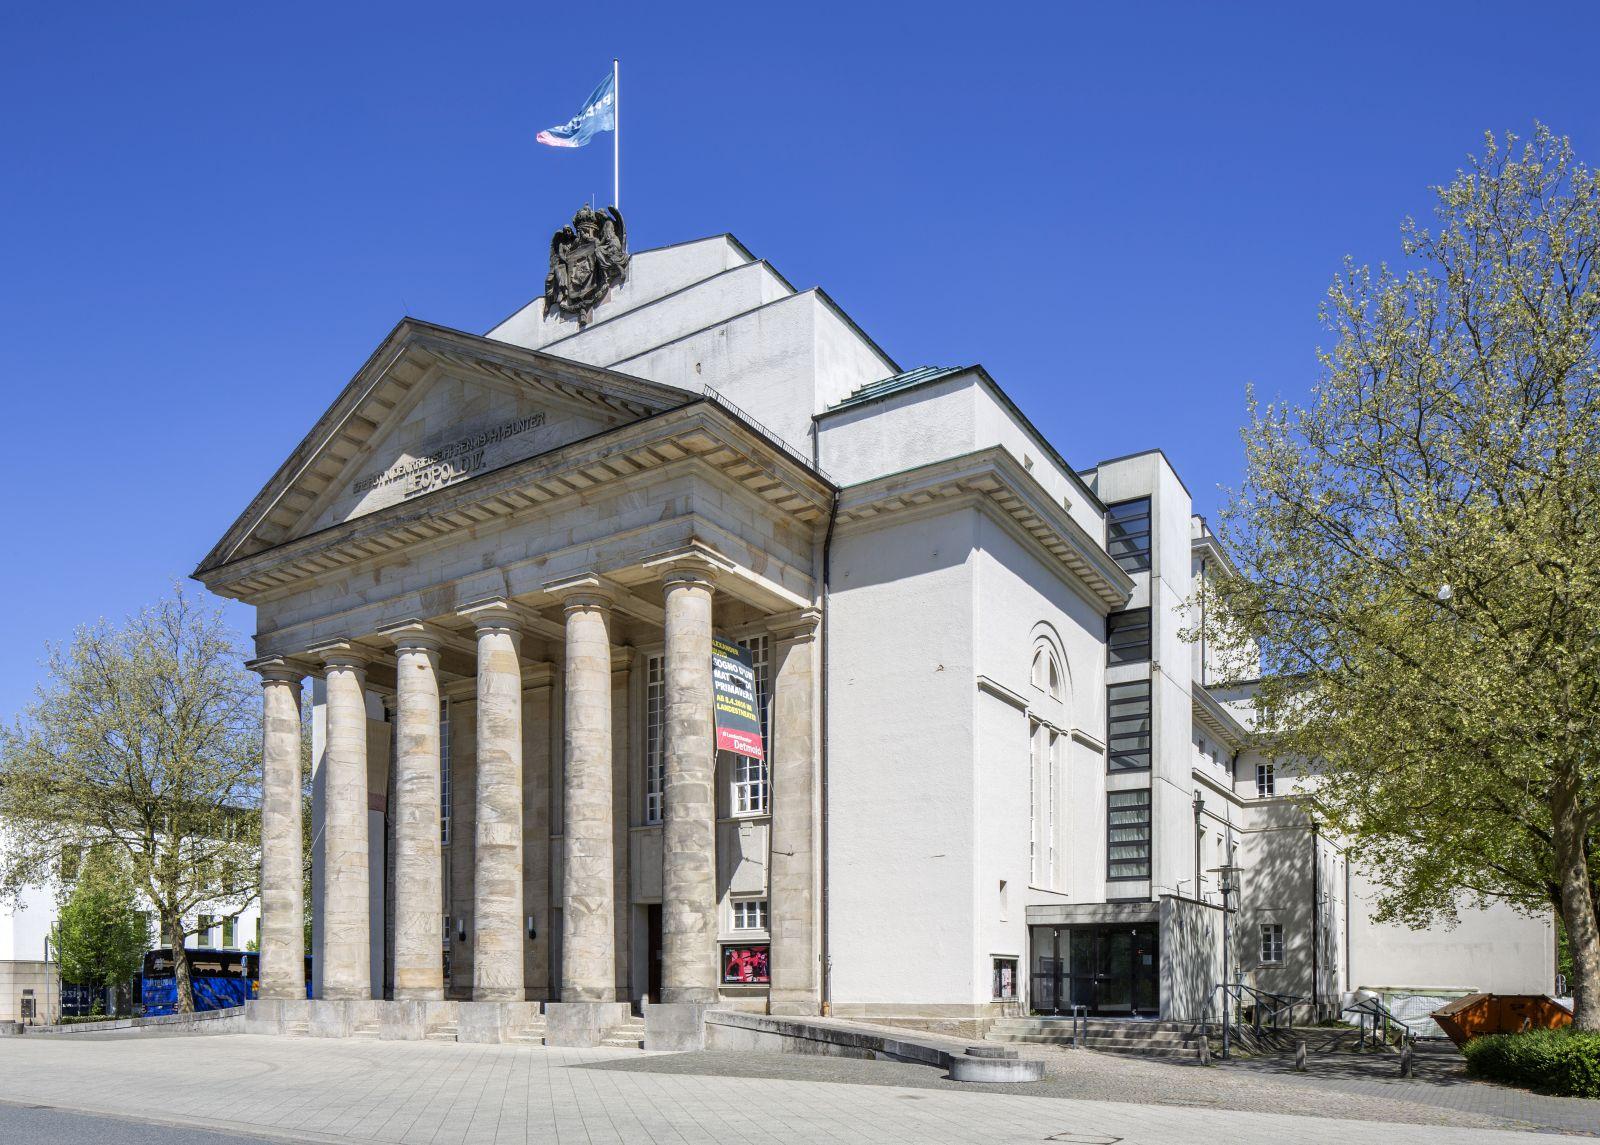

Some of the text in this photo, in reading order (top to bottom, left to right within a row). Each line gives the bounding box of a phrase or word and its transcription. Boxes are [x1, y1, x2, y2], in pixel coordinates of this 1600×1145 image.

[512, 412, 545, 434] UNTER
[404, 457, 471, 495] LEOPOLD
[714, 658, 739, 673] SOGNO
[715, 681, 754, 701] PRIMAVERA
[734, 739, 761, 756] Detmold
